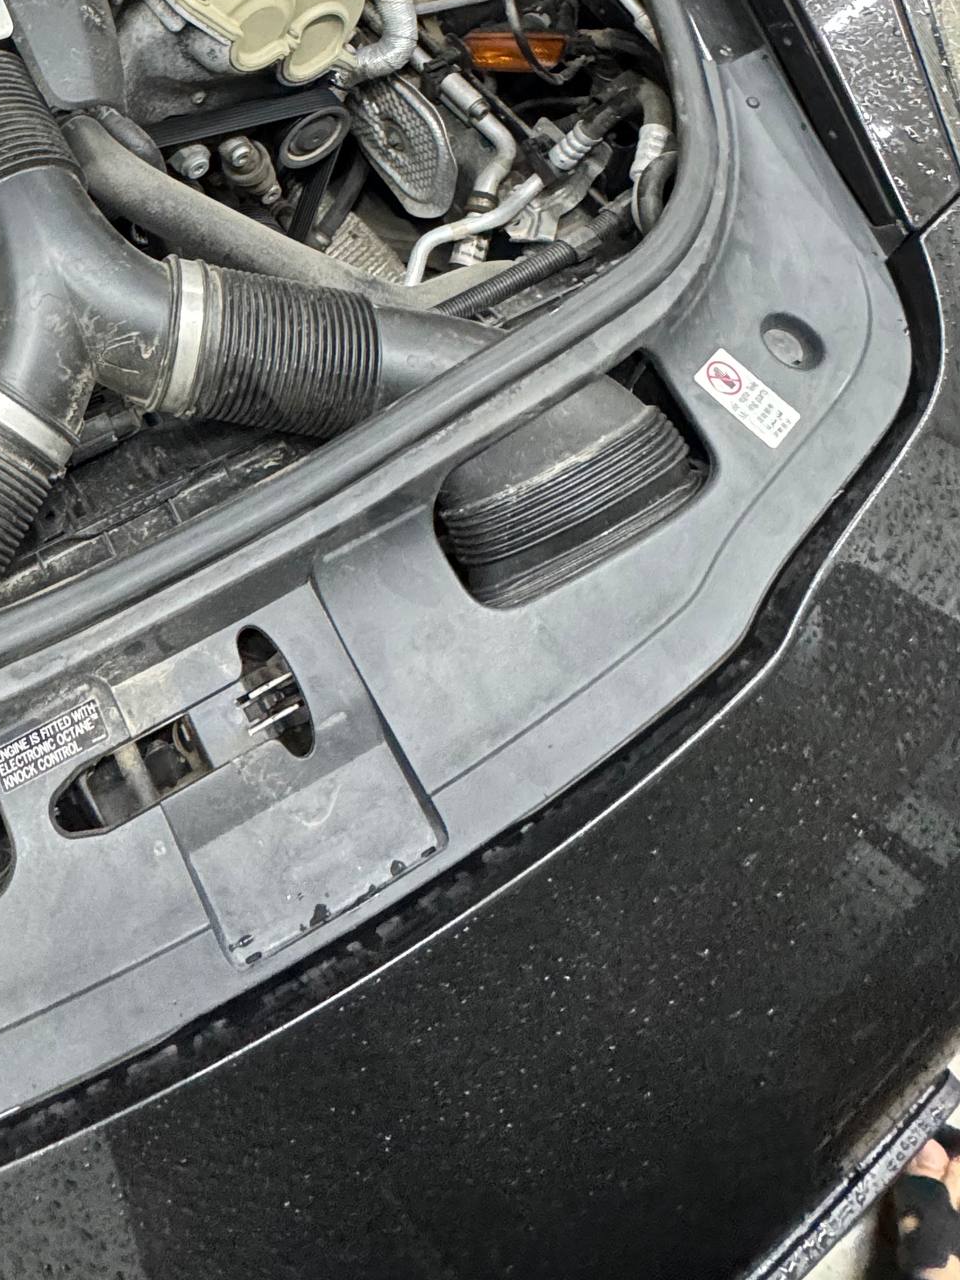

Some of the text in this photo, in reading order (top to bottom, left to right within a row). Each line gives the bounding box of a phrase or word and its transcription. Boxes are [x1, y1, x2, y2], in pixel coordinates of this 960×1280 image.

[29, 732, 40, 746] IS
[40, 715, 72, 740] FITTED
[71, 702, 96, 722] WITH
[2, 741, 83, 790] KNOCK CONTROL
